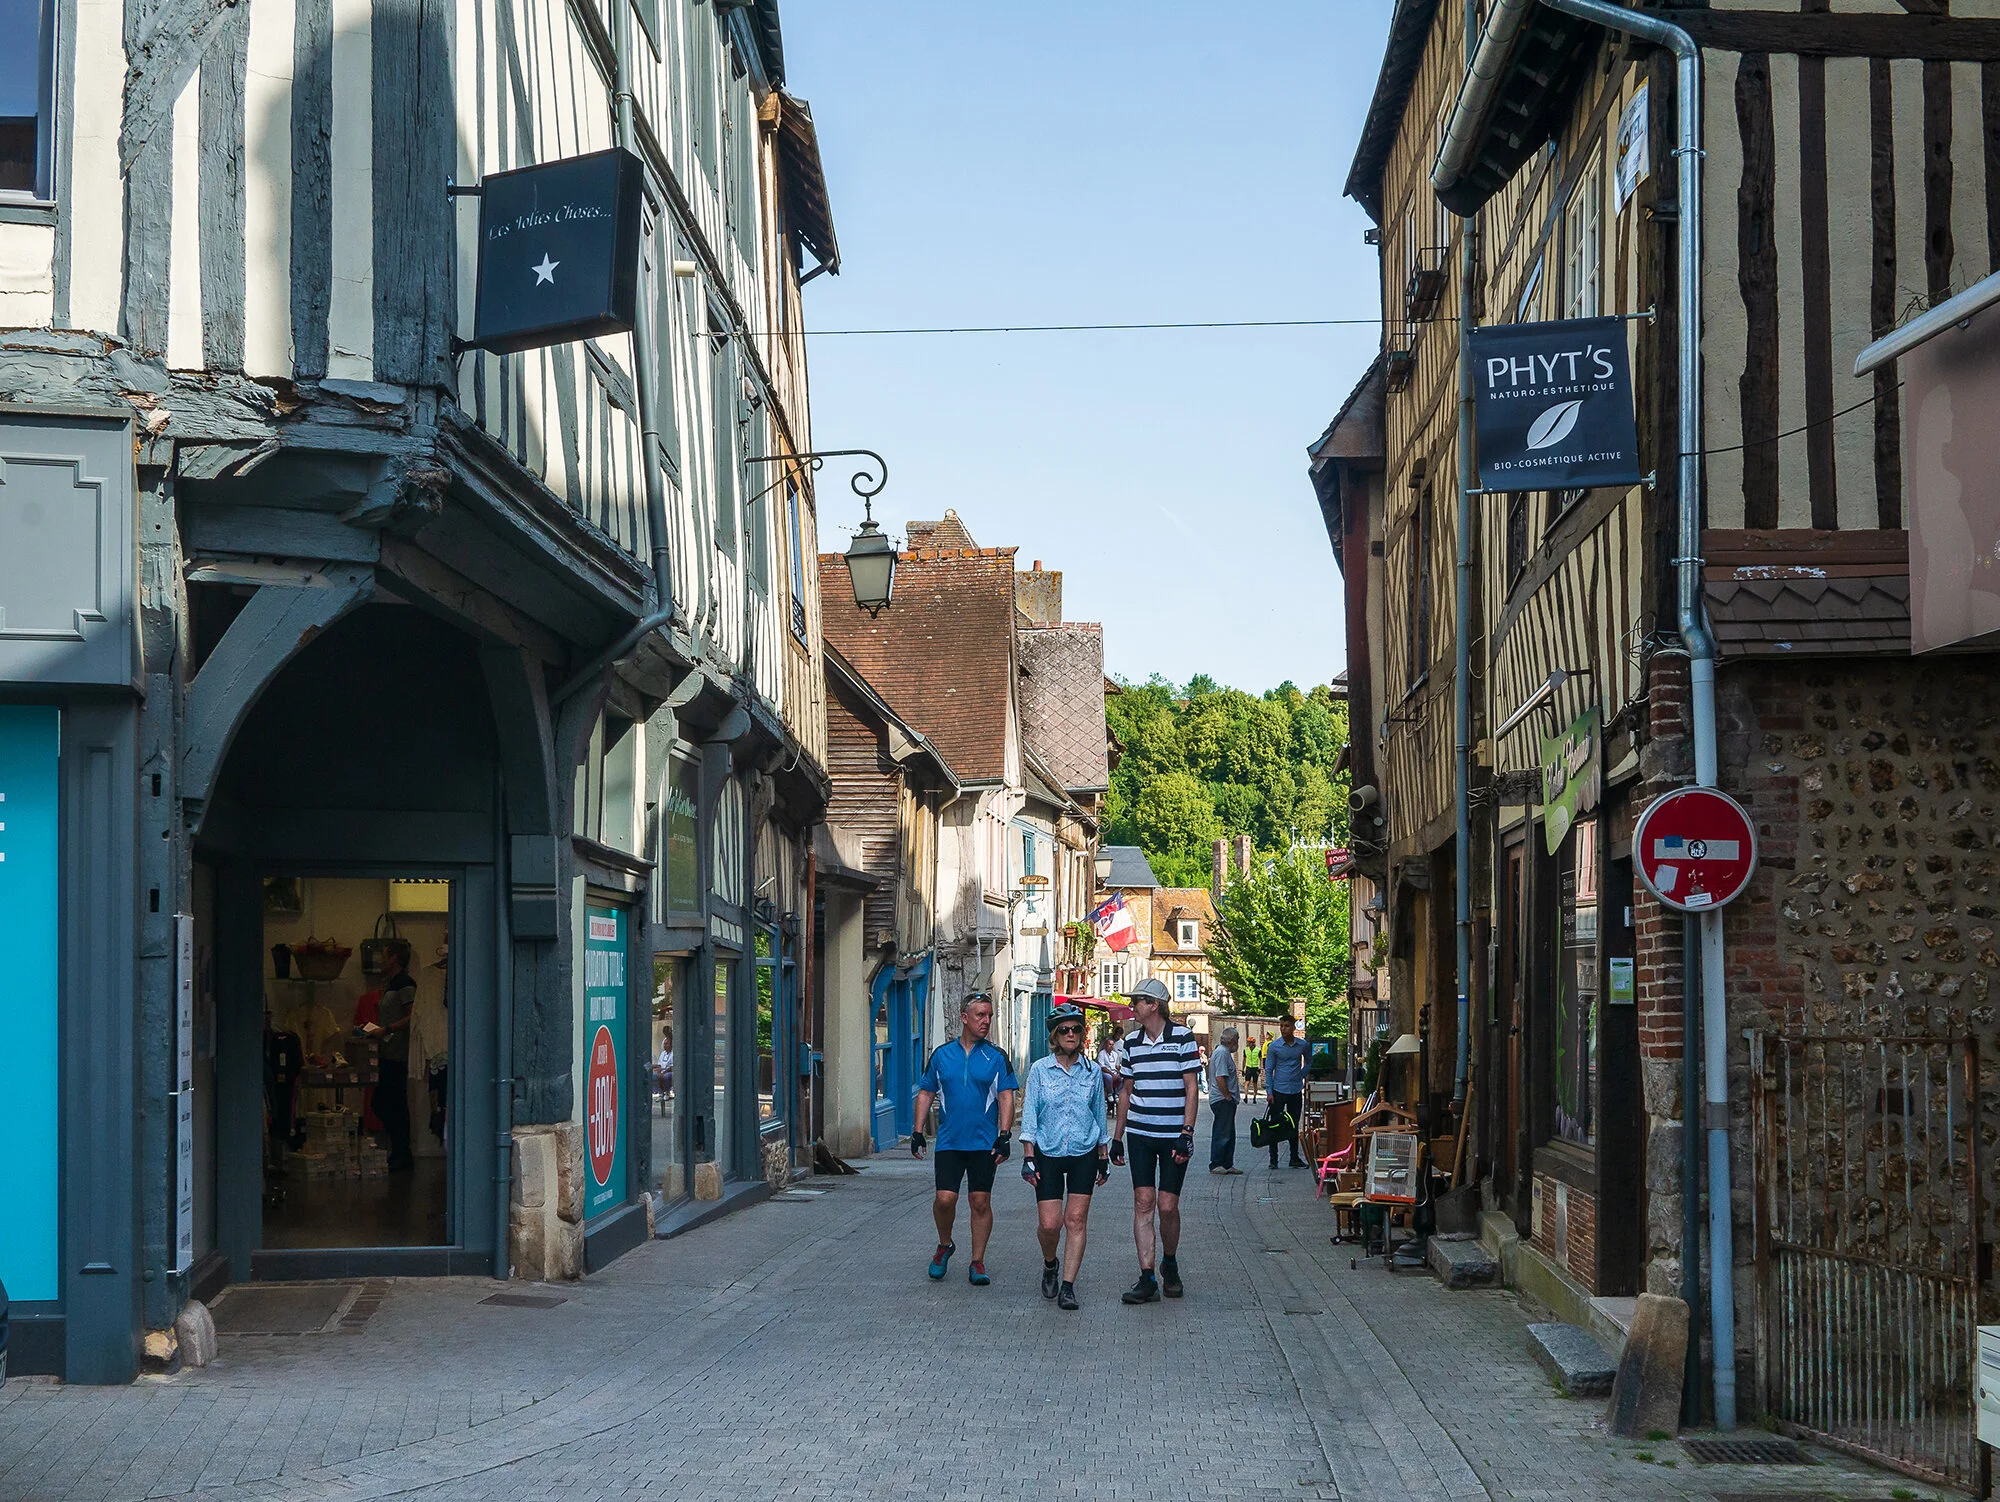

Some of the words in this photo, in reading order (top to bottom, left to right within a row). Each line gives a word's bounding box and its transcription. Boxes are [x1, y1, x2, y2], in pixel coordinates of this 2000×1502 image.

[488, 222, 511, 240] Les
[516, 206, 551, 231] Jolies
[1486, 344, 1614, 388] PHYT'S
[1490, 382, 1615, 400] NATURO-ESTHETIQUE
[1494, 454, 1583, 471] BIO-COSMÉTIQUE
[1588, 451, 1622, 462] ACTIVE
